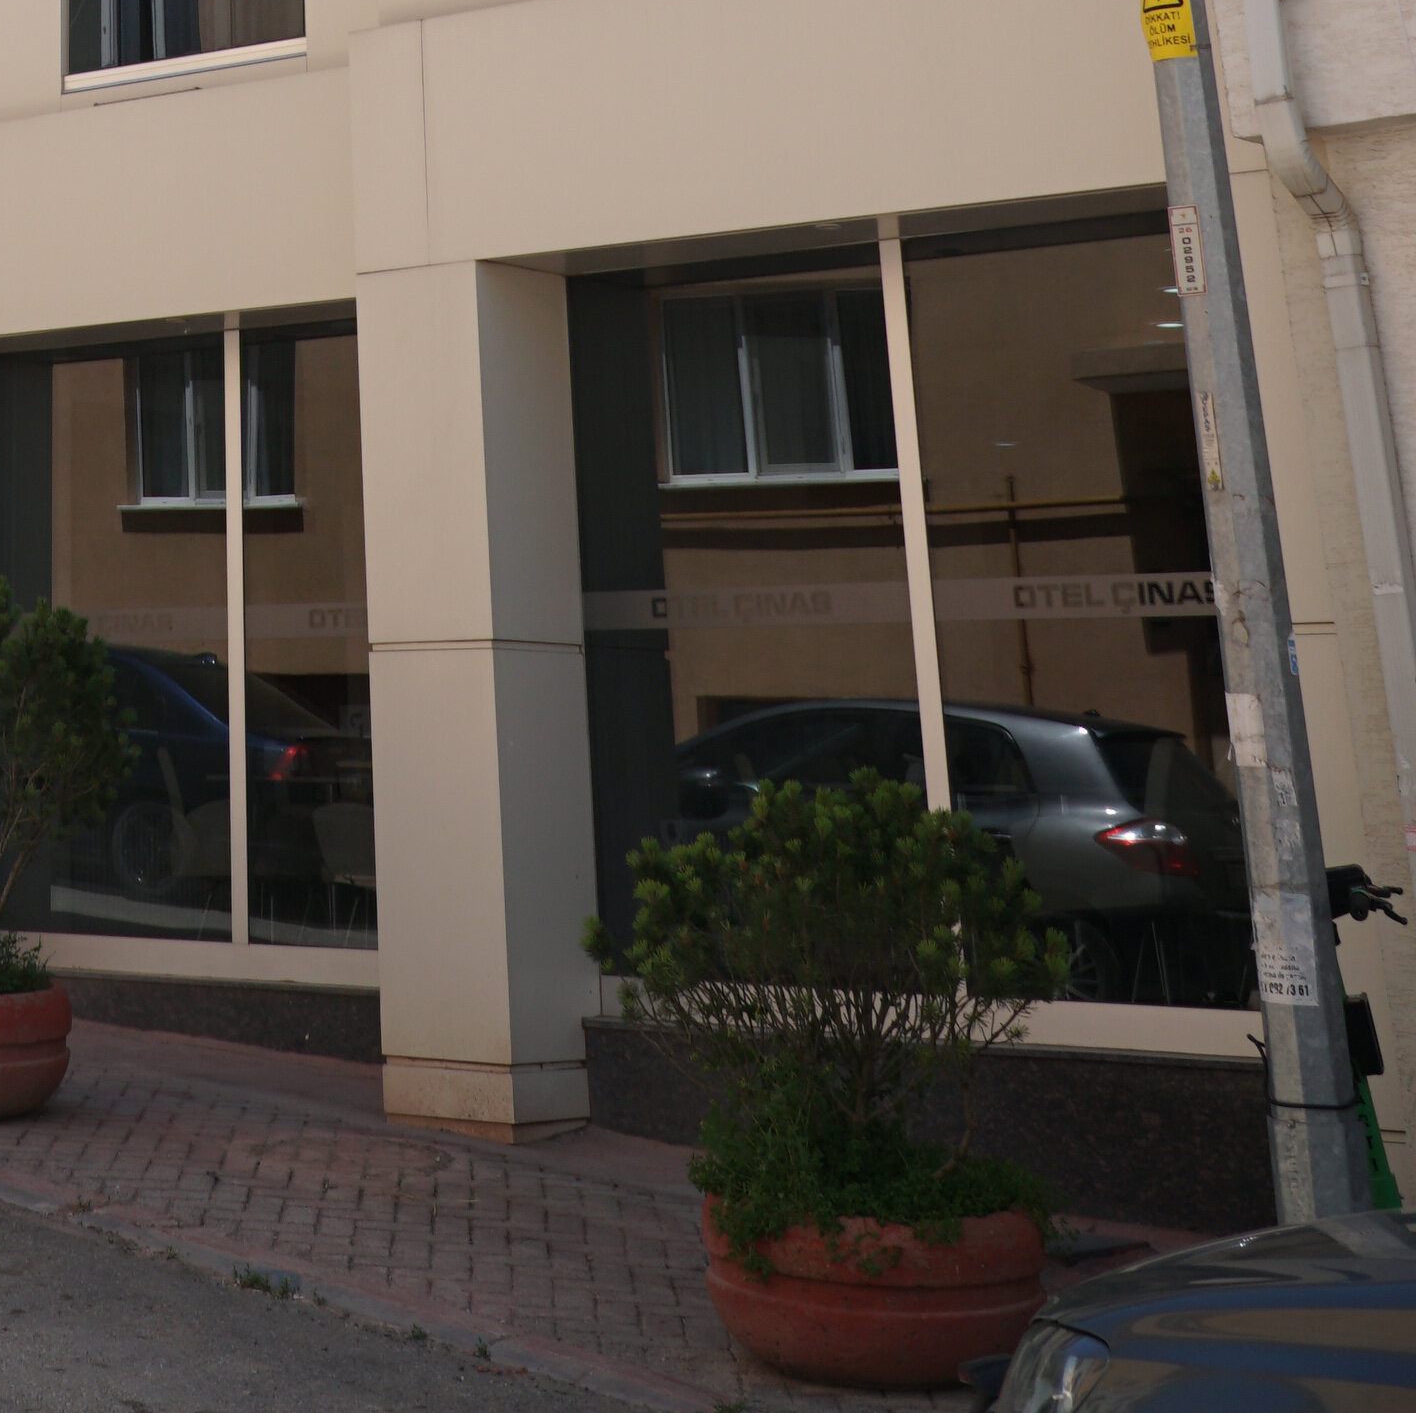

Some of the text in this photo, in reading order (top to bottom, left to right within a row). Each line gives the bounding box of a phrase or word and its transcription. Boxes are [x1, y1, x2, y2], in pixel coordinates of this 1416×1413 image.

[1149, 23, 1176, 36] ÖLÜM
[1148, 32, 1191, 49] EHLİKESİ
[1013, 583, 1104, 608] OTEL
